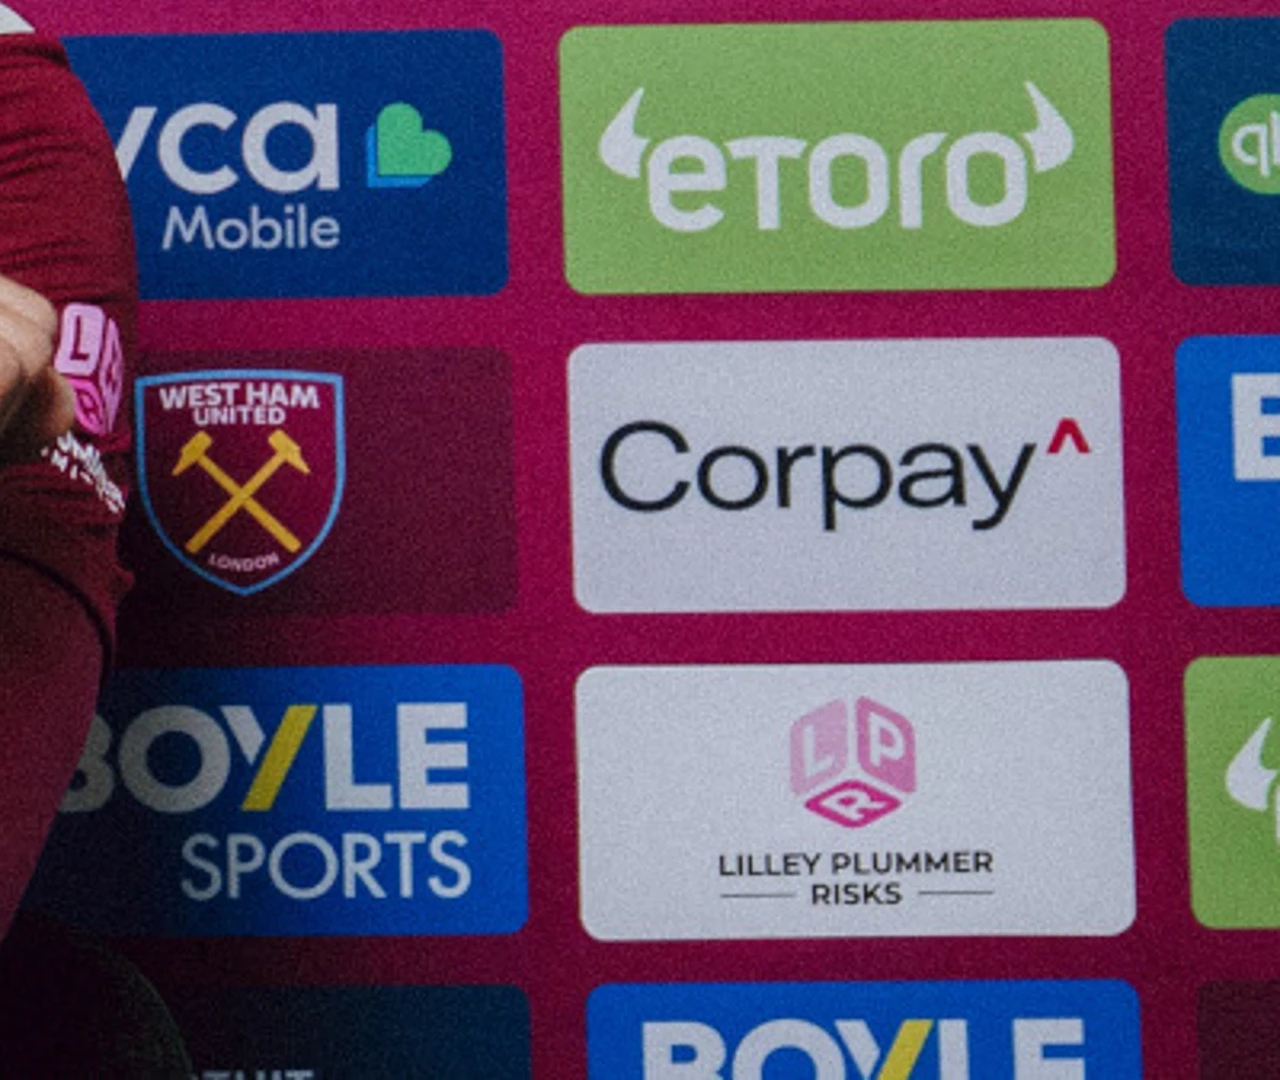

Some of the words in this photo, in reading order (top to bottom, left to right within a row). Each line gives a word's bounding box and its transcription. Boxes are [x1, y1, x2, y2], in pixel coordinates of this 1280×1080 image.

[161, 204, 341, 251] Mobile
[159, 383, 240, 410] WEST
[246, 383, 320, 410] HAM
[193, 405, 287, 426] UNITED
[599, 420, 1037, 532] Corpay
[207, 550, 281, 572] LONDON
[180, 831, 472, 901] SPORTS
[718, 852, 821, 878] LILLEY
[831, 850, 994, 876] PLUMMER
[810, 882, 903, 906] RISKS
